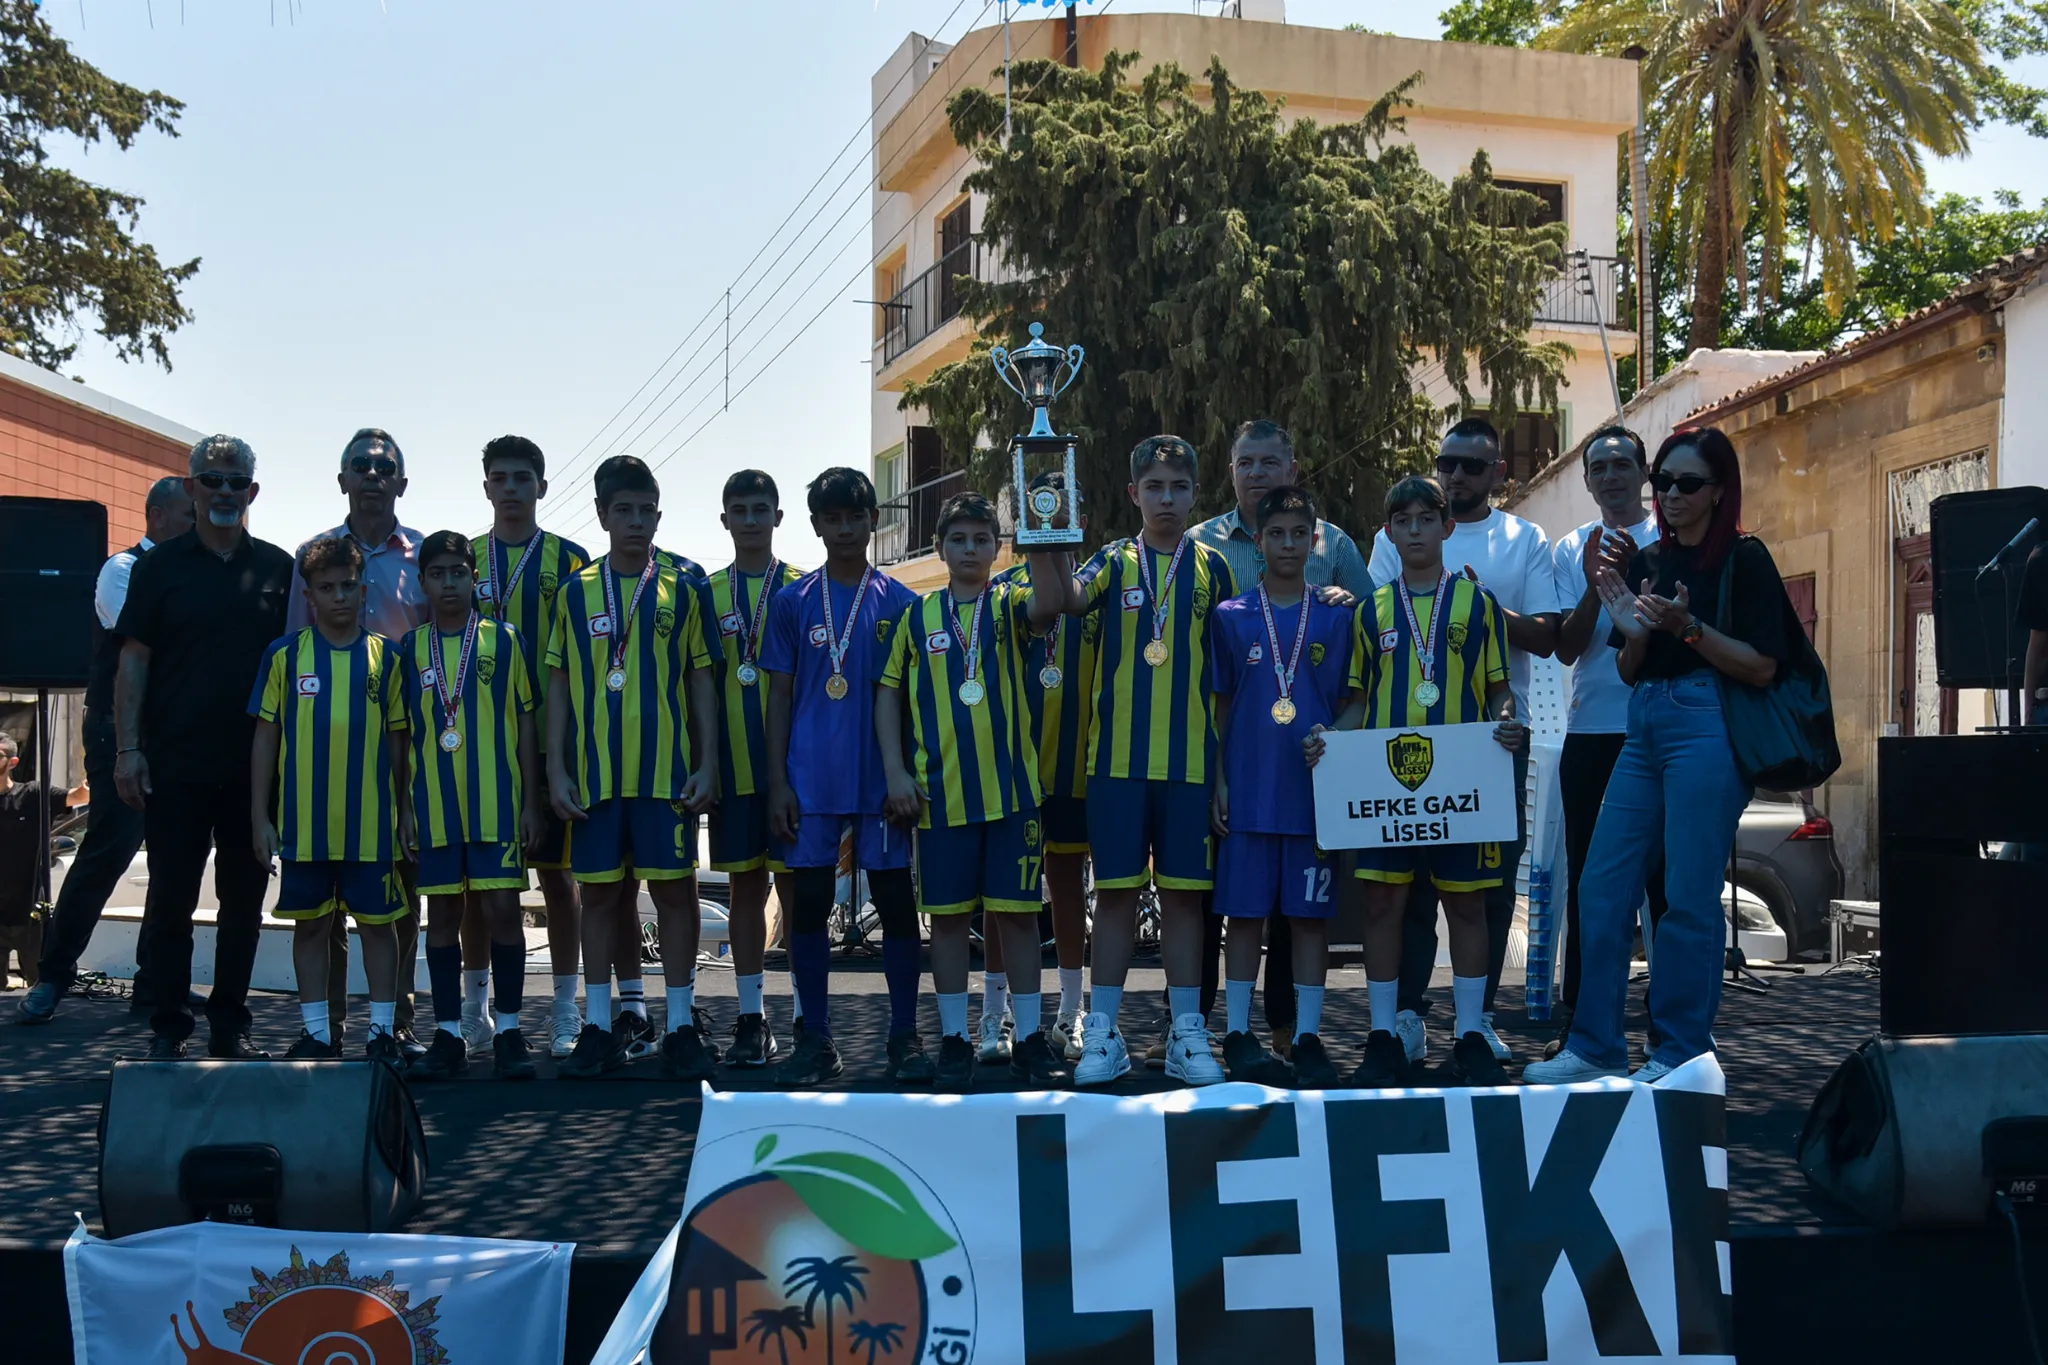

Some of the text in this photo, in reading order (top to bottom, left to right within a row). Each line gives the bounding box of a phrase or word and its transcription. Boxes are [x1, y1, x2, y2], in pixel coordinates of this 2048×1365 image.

[1347, 788, 1480, 819] LEFKE GAZİ
[1381, 816, 1449, 843] LİSESİ
[1017, 855, 1042, 891] 17
[1303, 866, 1332, 903] 12
[2010, 1180, 2036, 1193] M6
[227, 1203, 253, 1214] M6
[1016, 1090, 1736, 1365] LEFKE
